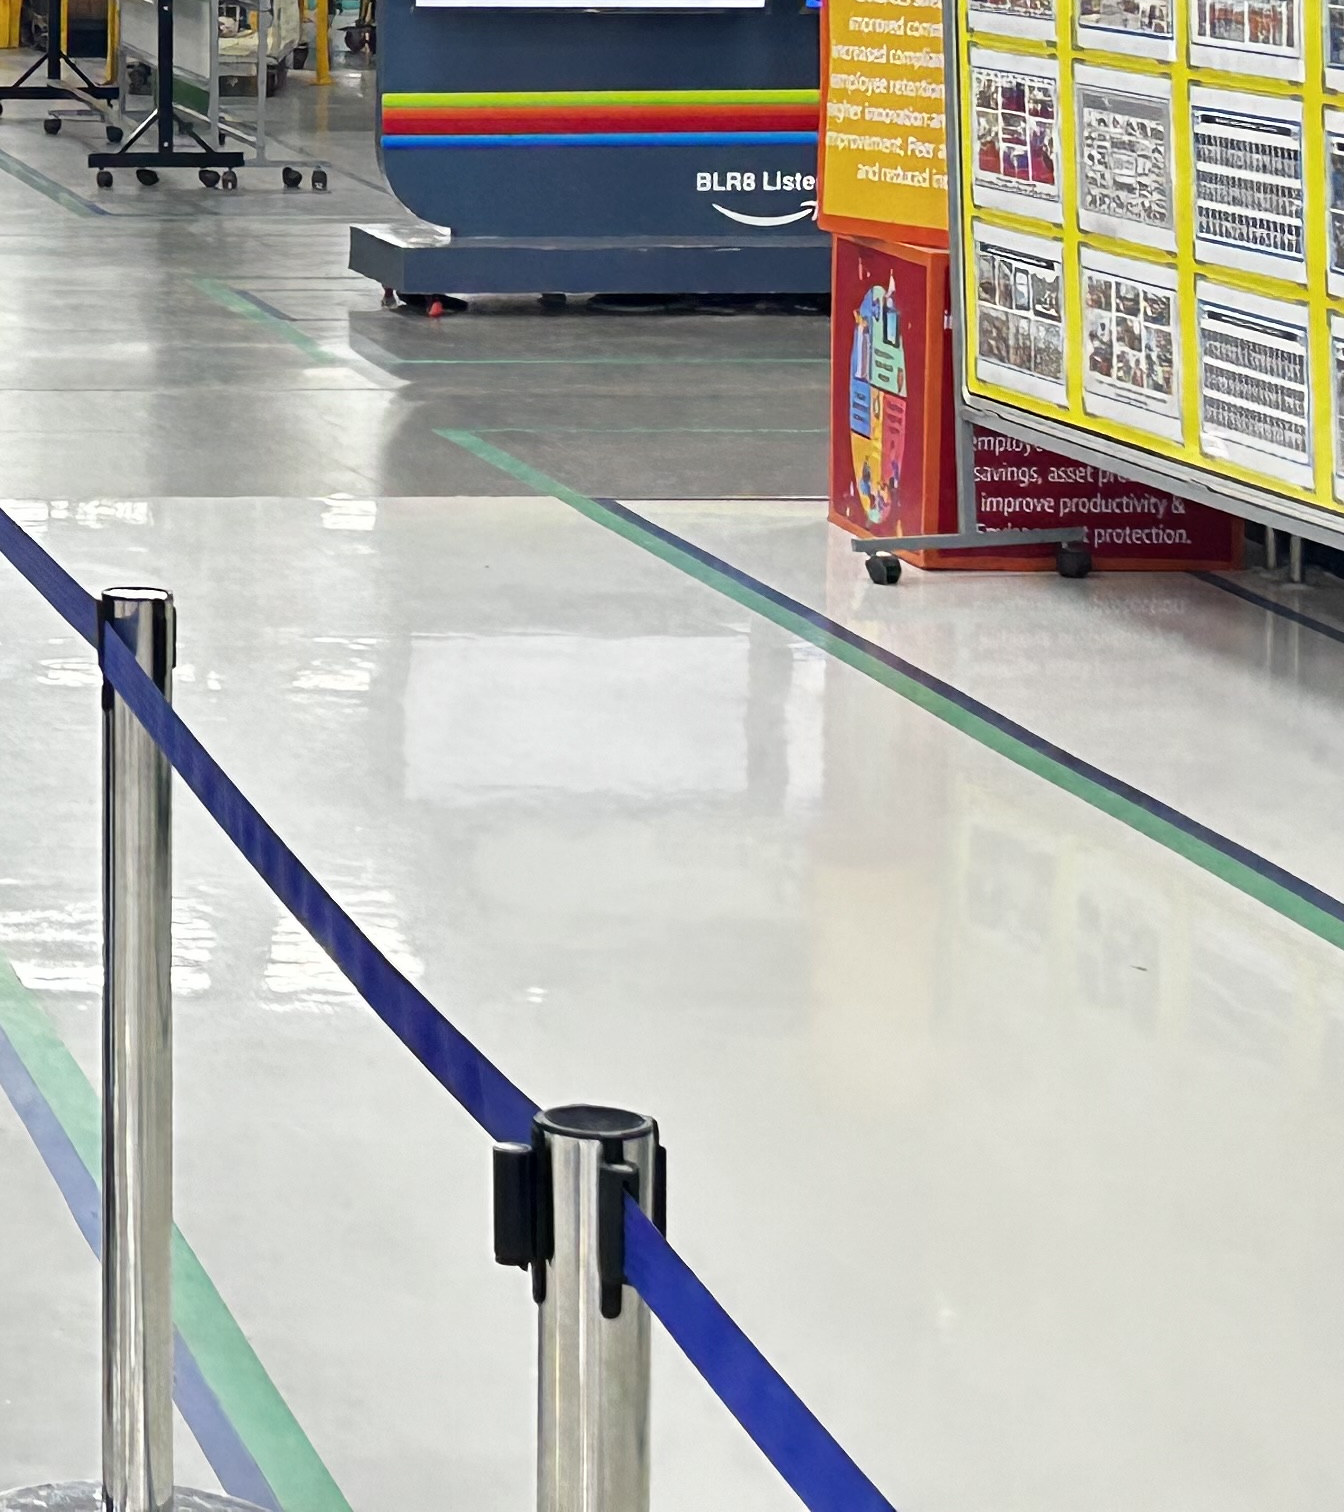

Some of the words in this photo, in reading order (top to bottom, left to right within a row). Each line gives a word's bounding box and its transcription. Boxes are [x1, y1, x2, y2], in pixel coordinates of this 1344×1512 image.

[889, 47, 945, 71] complian
[830, 71, 888, 97] employee
[696, 171, 756, 191] BLR8
[762, 170, 816, 191] Liste
[856, 161, 880, 182] and
[974, 462, 1043, 487] savings,
[1047, 465, 1093, 483] asset
[981, 491, 1055, 516] improve
[1059, 491, 1167, 519] productivity
[1171, 495, 1186, 515] &
[1093, 524, 1193, 549] protection.
